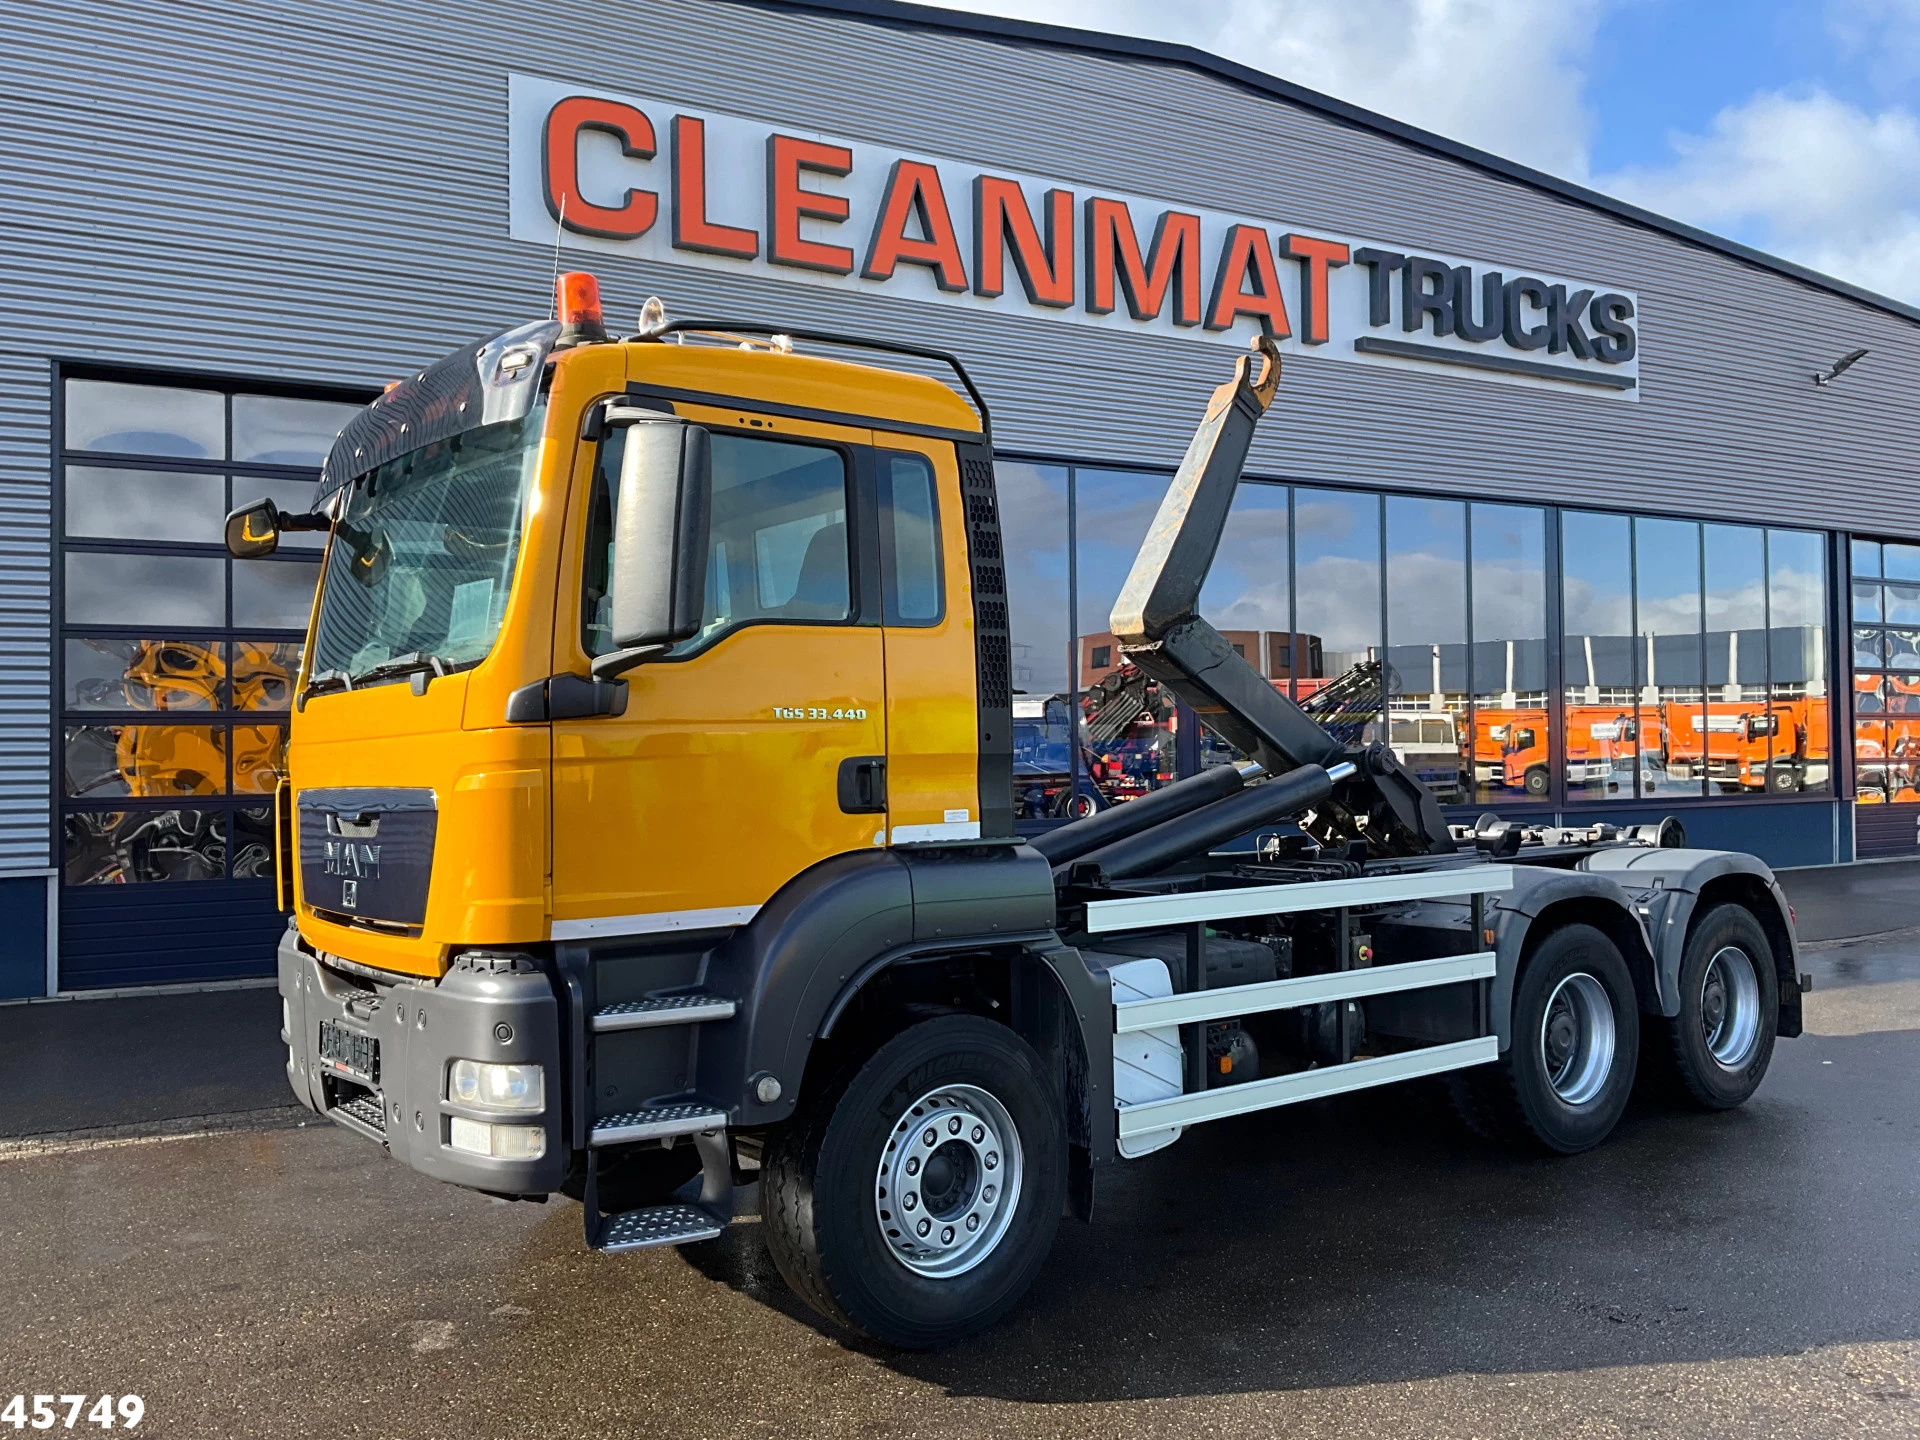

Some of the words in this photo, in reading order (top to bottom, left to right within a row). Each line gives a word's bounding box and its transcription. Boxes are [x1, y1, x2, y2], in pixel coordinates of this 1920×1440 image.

[541, 96, 1349, 345] CLEANMAT
[1354, 246, 1637, 365] TRUCKS
[773, 707, 804, 719] TGS
[807, 708, 867, 720] 33.440
[324, 841, 382, 879] MAN
